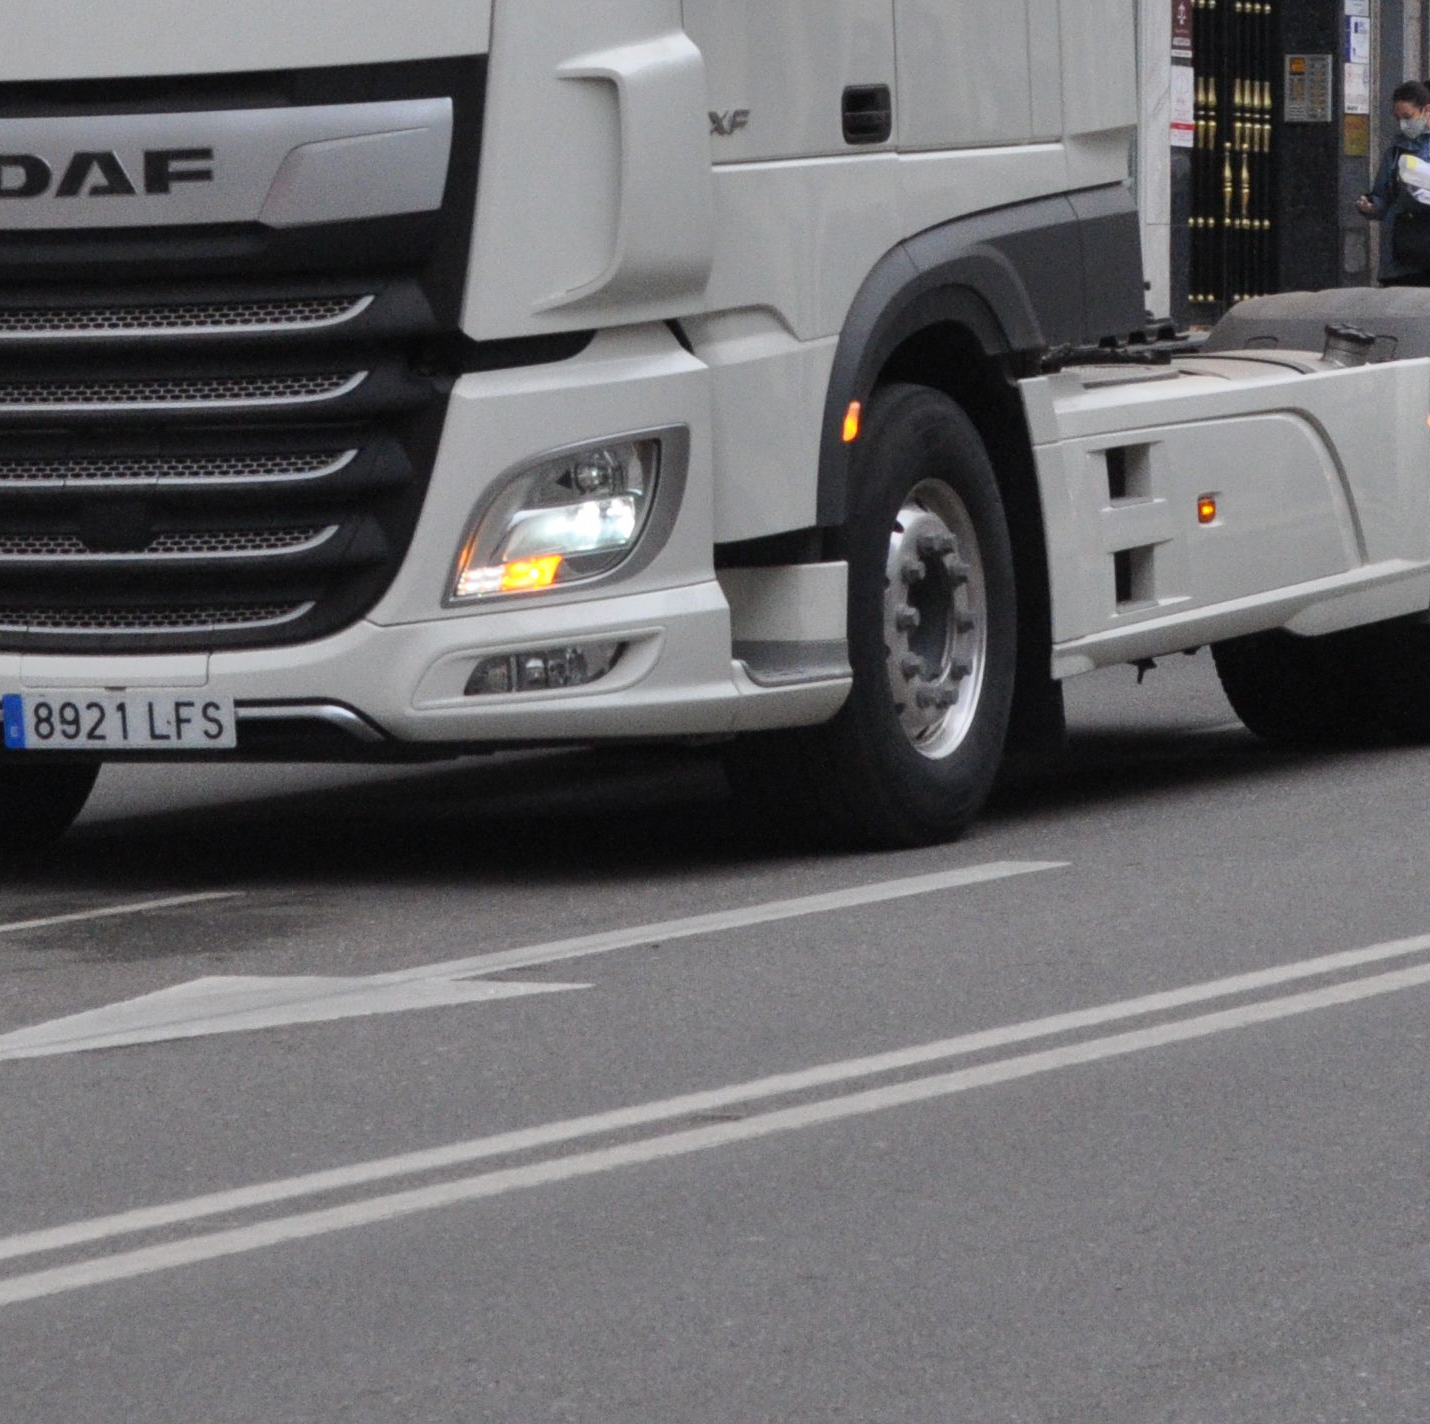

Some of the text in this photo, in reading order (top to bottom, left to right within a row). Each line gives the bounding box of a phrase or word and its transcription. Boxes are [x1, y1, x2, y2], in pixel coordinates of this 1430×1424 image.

[707, 108, 751, 137] XF
[32, 700, 129, 741] 8921
[146, 700, 225, 741] LFS
